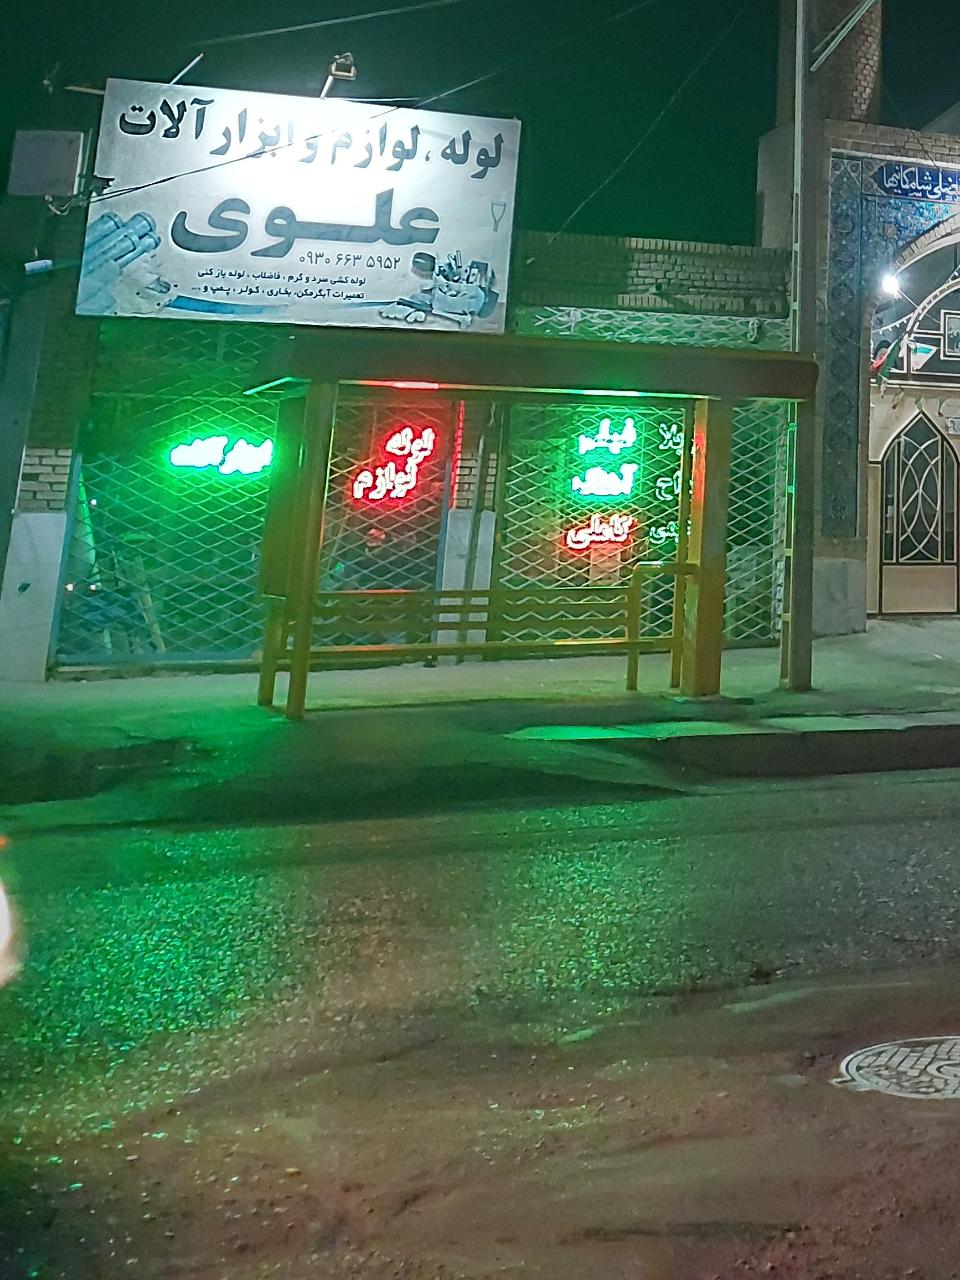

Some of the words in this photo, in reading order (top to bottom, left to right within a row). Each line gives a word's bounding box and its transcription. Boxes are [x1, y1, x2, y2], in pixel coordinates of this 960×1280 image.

[119, 97, 215, 141] آلات
[209, 107, 295, 159] ابزار
[299, 137, 318, 164] و
[331, 121, 421, 172] لوازم
[170, 187, 441, 258] علوی
[299, 250, 331, 265] ۰۹۳۰
[335, 253, 363, 266] ۶۶۳
[366, 255, 401, 269] ۵۹۵۲
